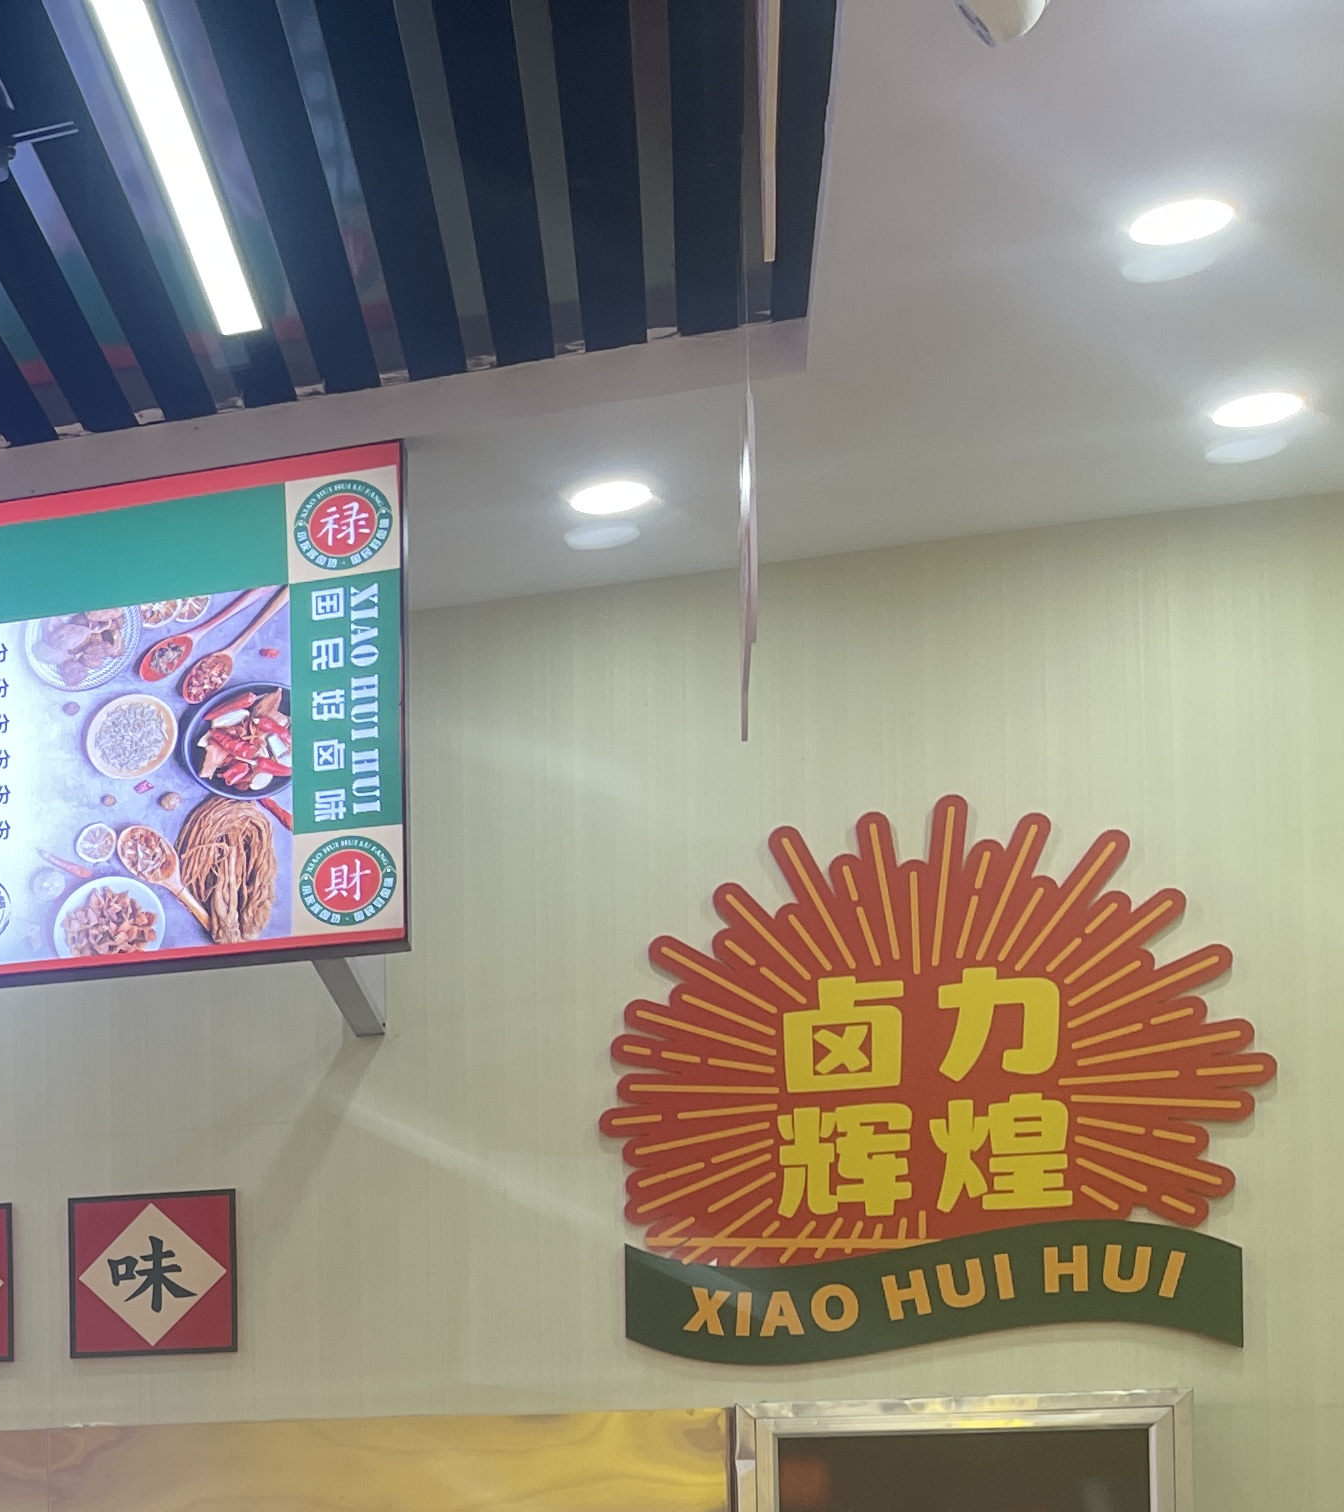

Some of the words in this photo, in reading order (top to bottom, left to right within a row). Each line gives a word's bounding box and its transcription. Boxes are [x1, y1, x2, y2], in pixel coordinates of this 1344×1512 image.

[316, 501, 371, 547] 禄
[350, 582, 380, 668] XIAO
[350, 673, 380, 740] HUI
[351, 747, 382, 815] HUI
[324, 858, 372, 902] 財
[782, 966, 1060, 1092] 卤力
[778, 1092, 1074, 1218] 辉煌
[683, 1284, 859, 1338] XIAO
[881, 1253, 1016, 1322] HUI
[1042, 1243, 1186, 1299] HUI
